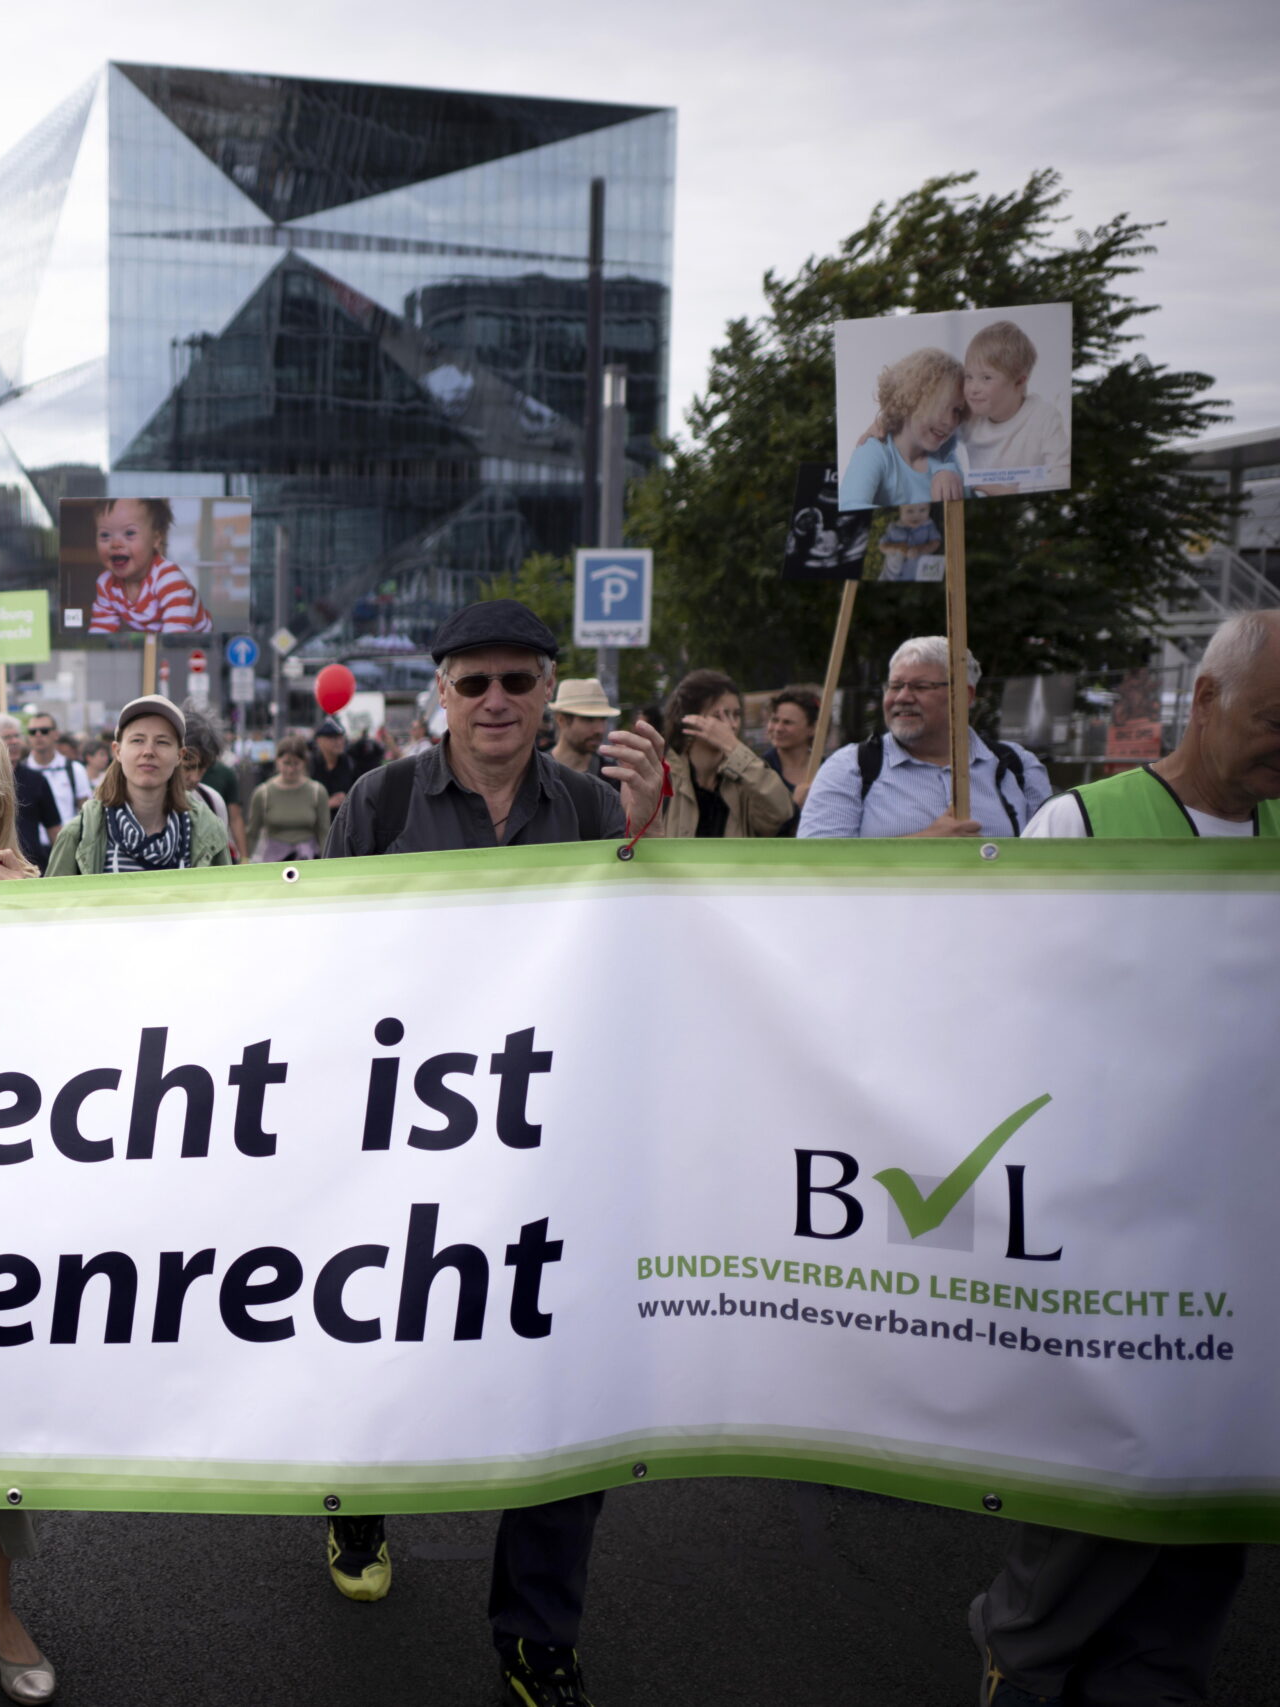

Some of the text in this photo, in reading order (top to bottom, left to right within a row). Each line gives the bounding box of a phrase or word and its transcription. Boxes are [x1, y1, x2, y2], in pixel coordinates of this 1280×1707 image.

[602, 578, 628, 616] P
[362, 1018, 552, 1150] ist
[637, 1255, 1235, 1318] BUNDESVERBAND LEBENSRECHT E.V.
[637, 1293, 1235, 1361] www.bundesverband-lebensrecht.de
